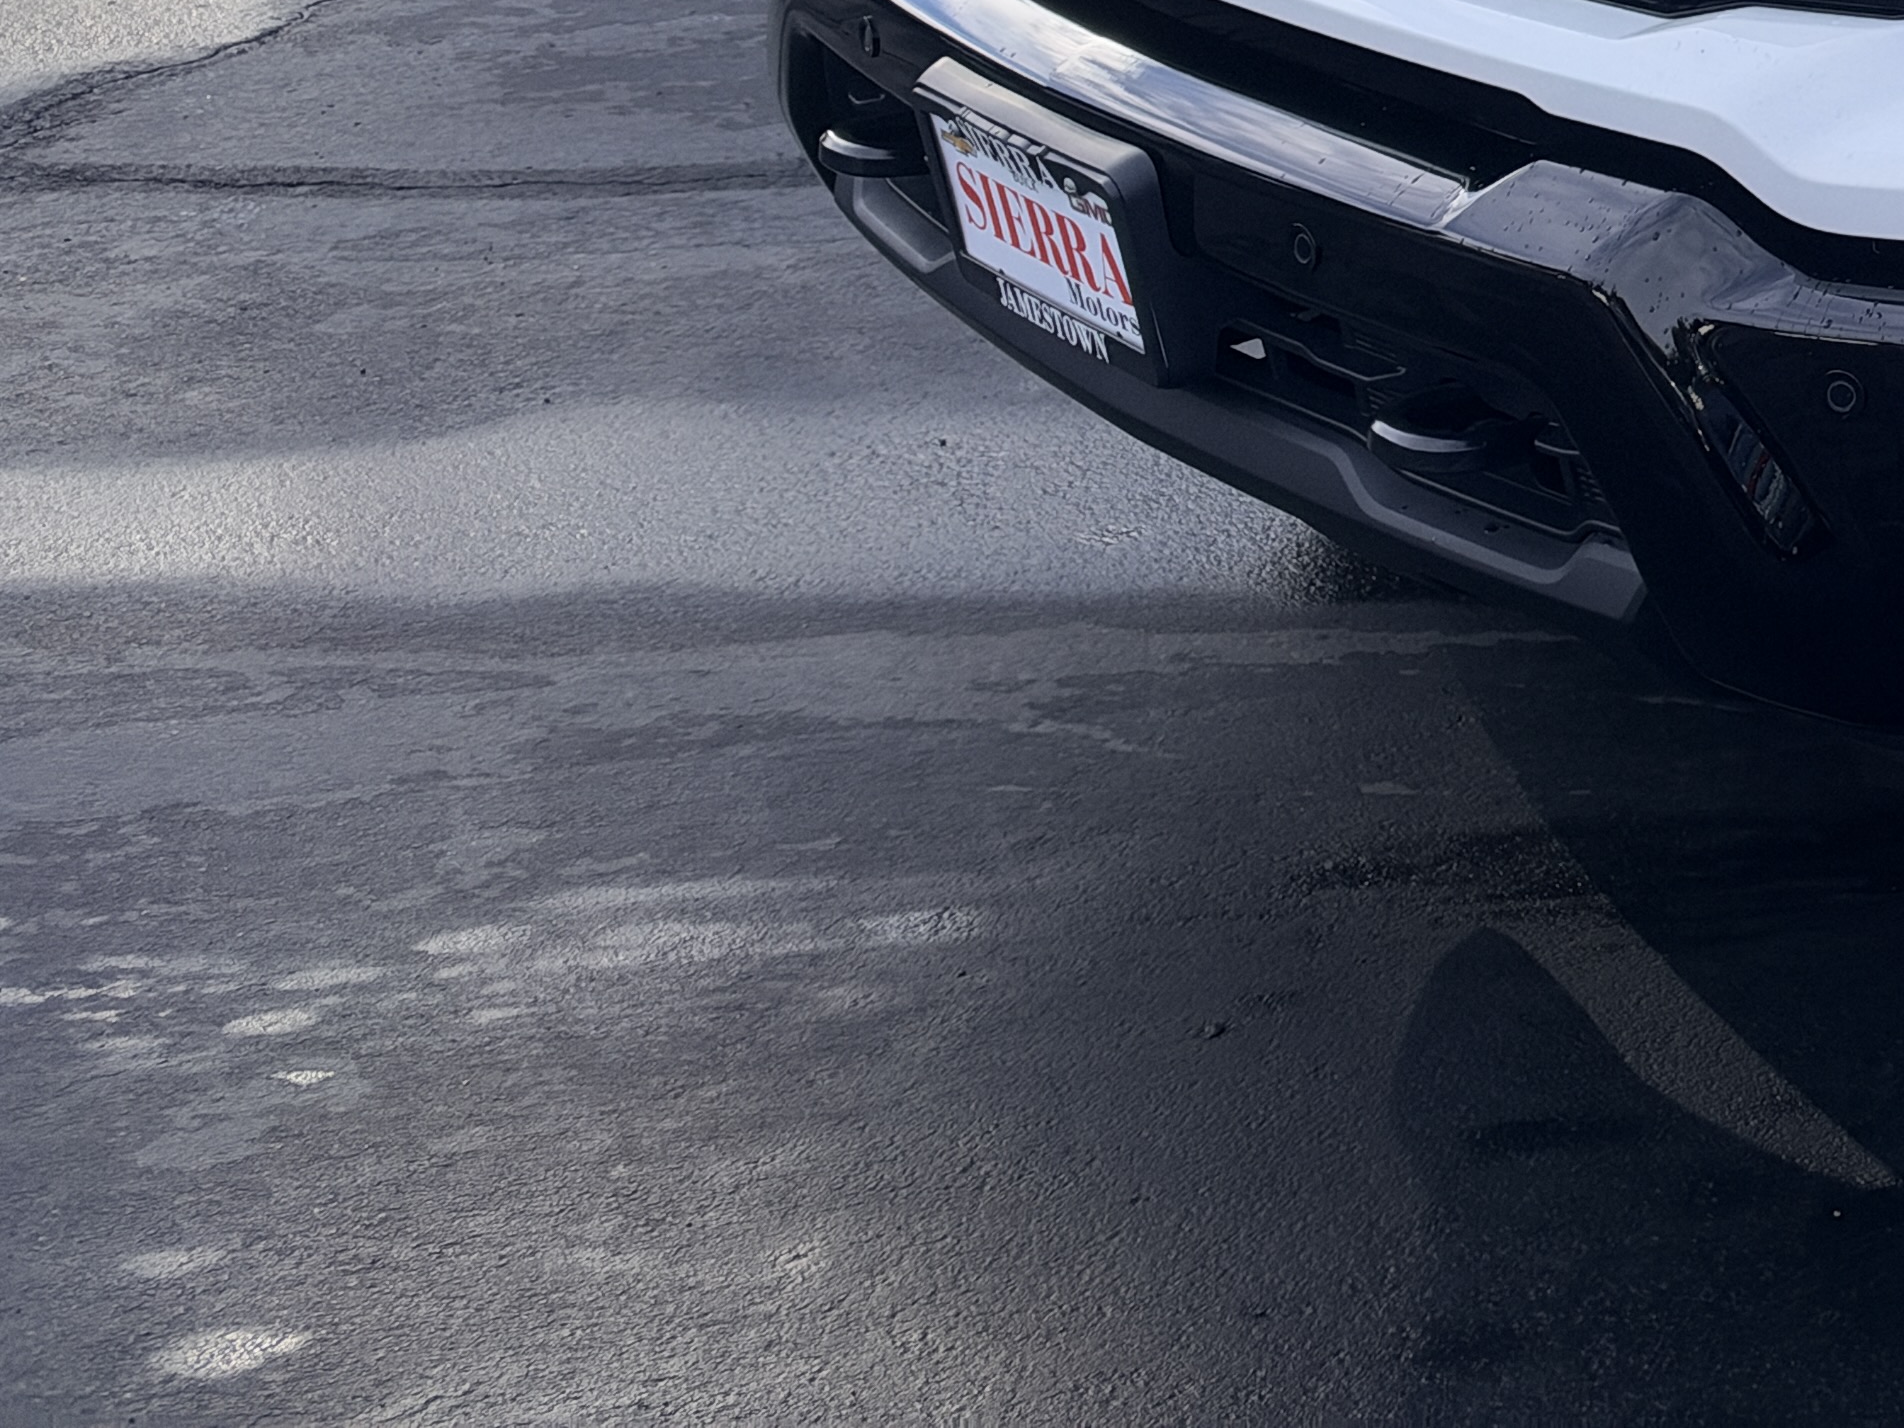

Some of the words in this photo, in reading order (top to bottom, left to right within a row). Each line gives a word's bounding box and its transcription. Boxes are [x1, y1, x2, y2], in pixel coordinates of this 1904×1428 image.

[955, 115, 1061, 191] SIERRA
[956, 161, 1134, 307] SIERRA
[1067, 194, 1113, 227] GMC
[996, 277, 1110, 365] JAMESTOWN
[1064, 276, 1142, 336] Motors
